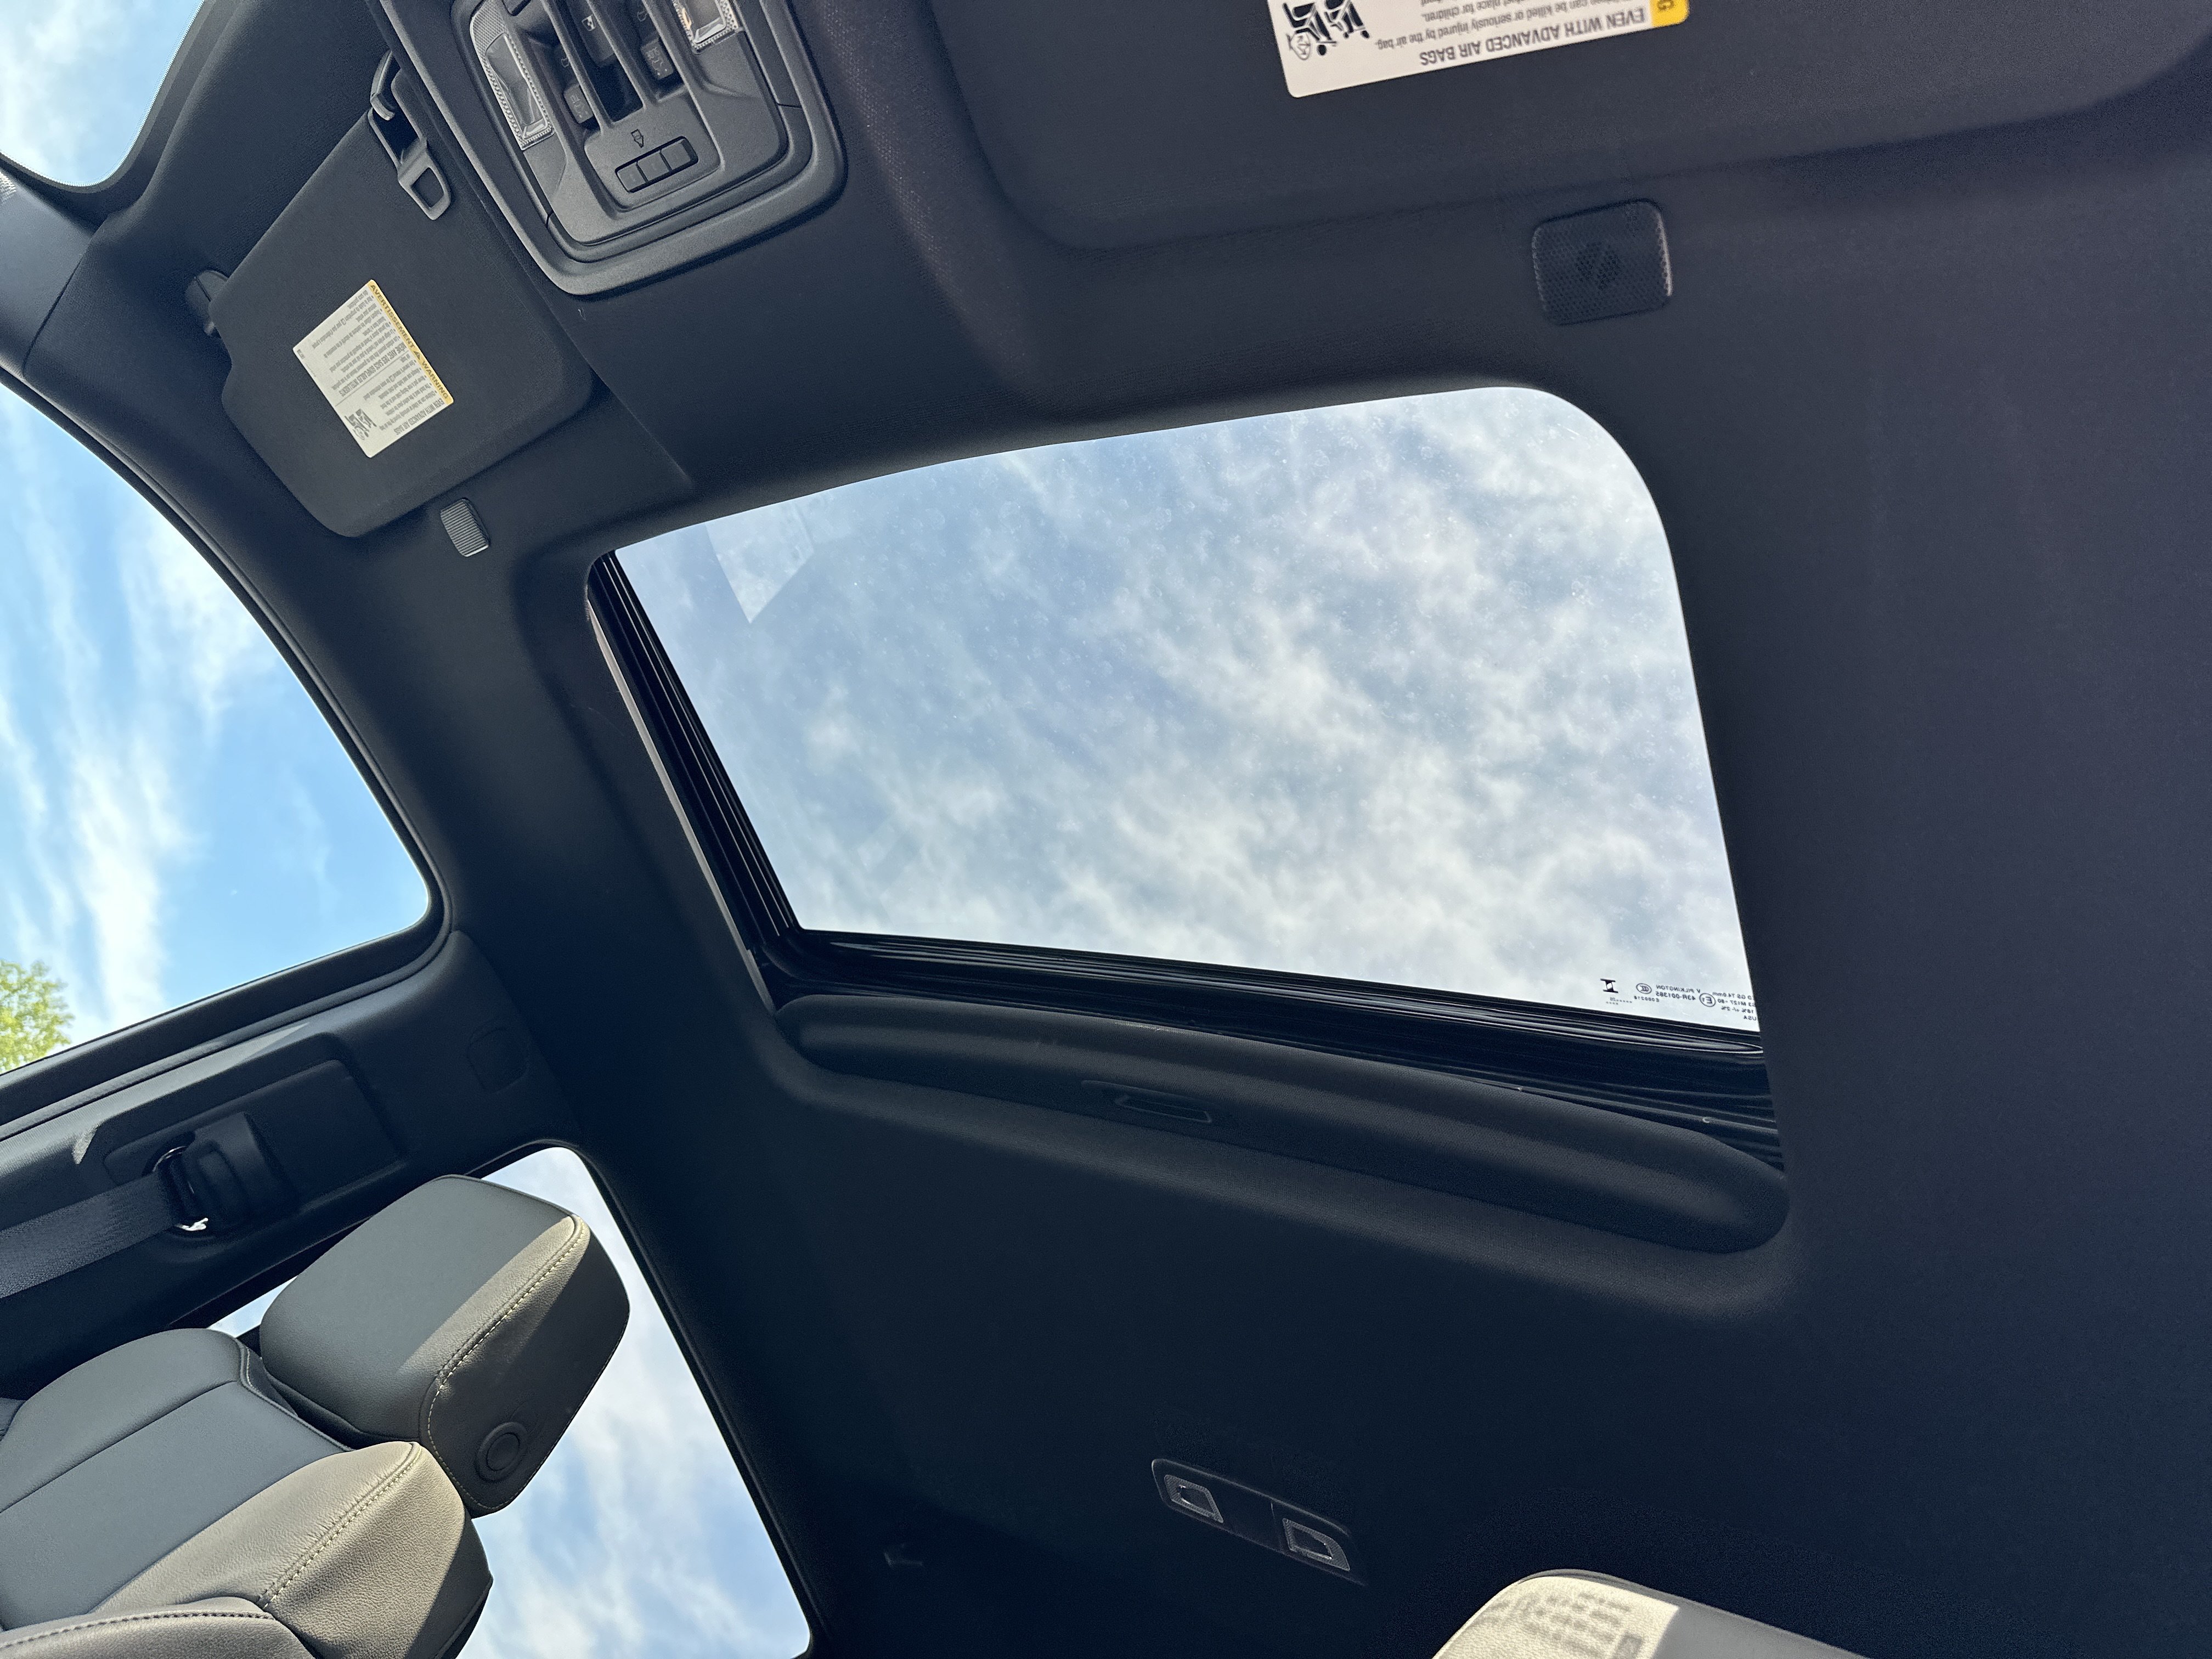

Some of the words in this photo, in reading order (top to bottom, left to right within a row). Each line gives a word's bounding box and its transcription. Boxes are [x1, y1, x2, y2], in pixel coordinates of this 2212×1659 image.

[1421, 7, 1460, 22] children.
[1462, 4, 1474, 14] for
[1526, 5, 1552, 19] killed
[1554, 2, 1567, 13] be
[1471, 14, 1512, 30] seriously
[1514, 11, 1523, 20] or
[1606, 7, 1645, 29] EVEN
[1437, 22, 1469, 37] injured
[1564, 16, 1604, 37] WITH
[1409, 33, 1423, 43] the
[1425, 28, 1436, 40] by
[1486, 25, 1559, 52] ADVANCED
[1374, 38, 1394, 50] bag.
[1395, 36, 1407, 47] air
[1419, 46, 1456, 65] BAGS
[1460, 41, 1481, 58] AIR
[370, 284, 415, 348] AVERTISSEMENT
[421, 360, 449, 399] WARNING
[425, 404, 435, 414] WITH
[433, 398, 444, 408] EVEN
